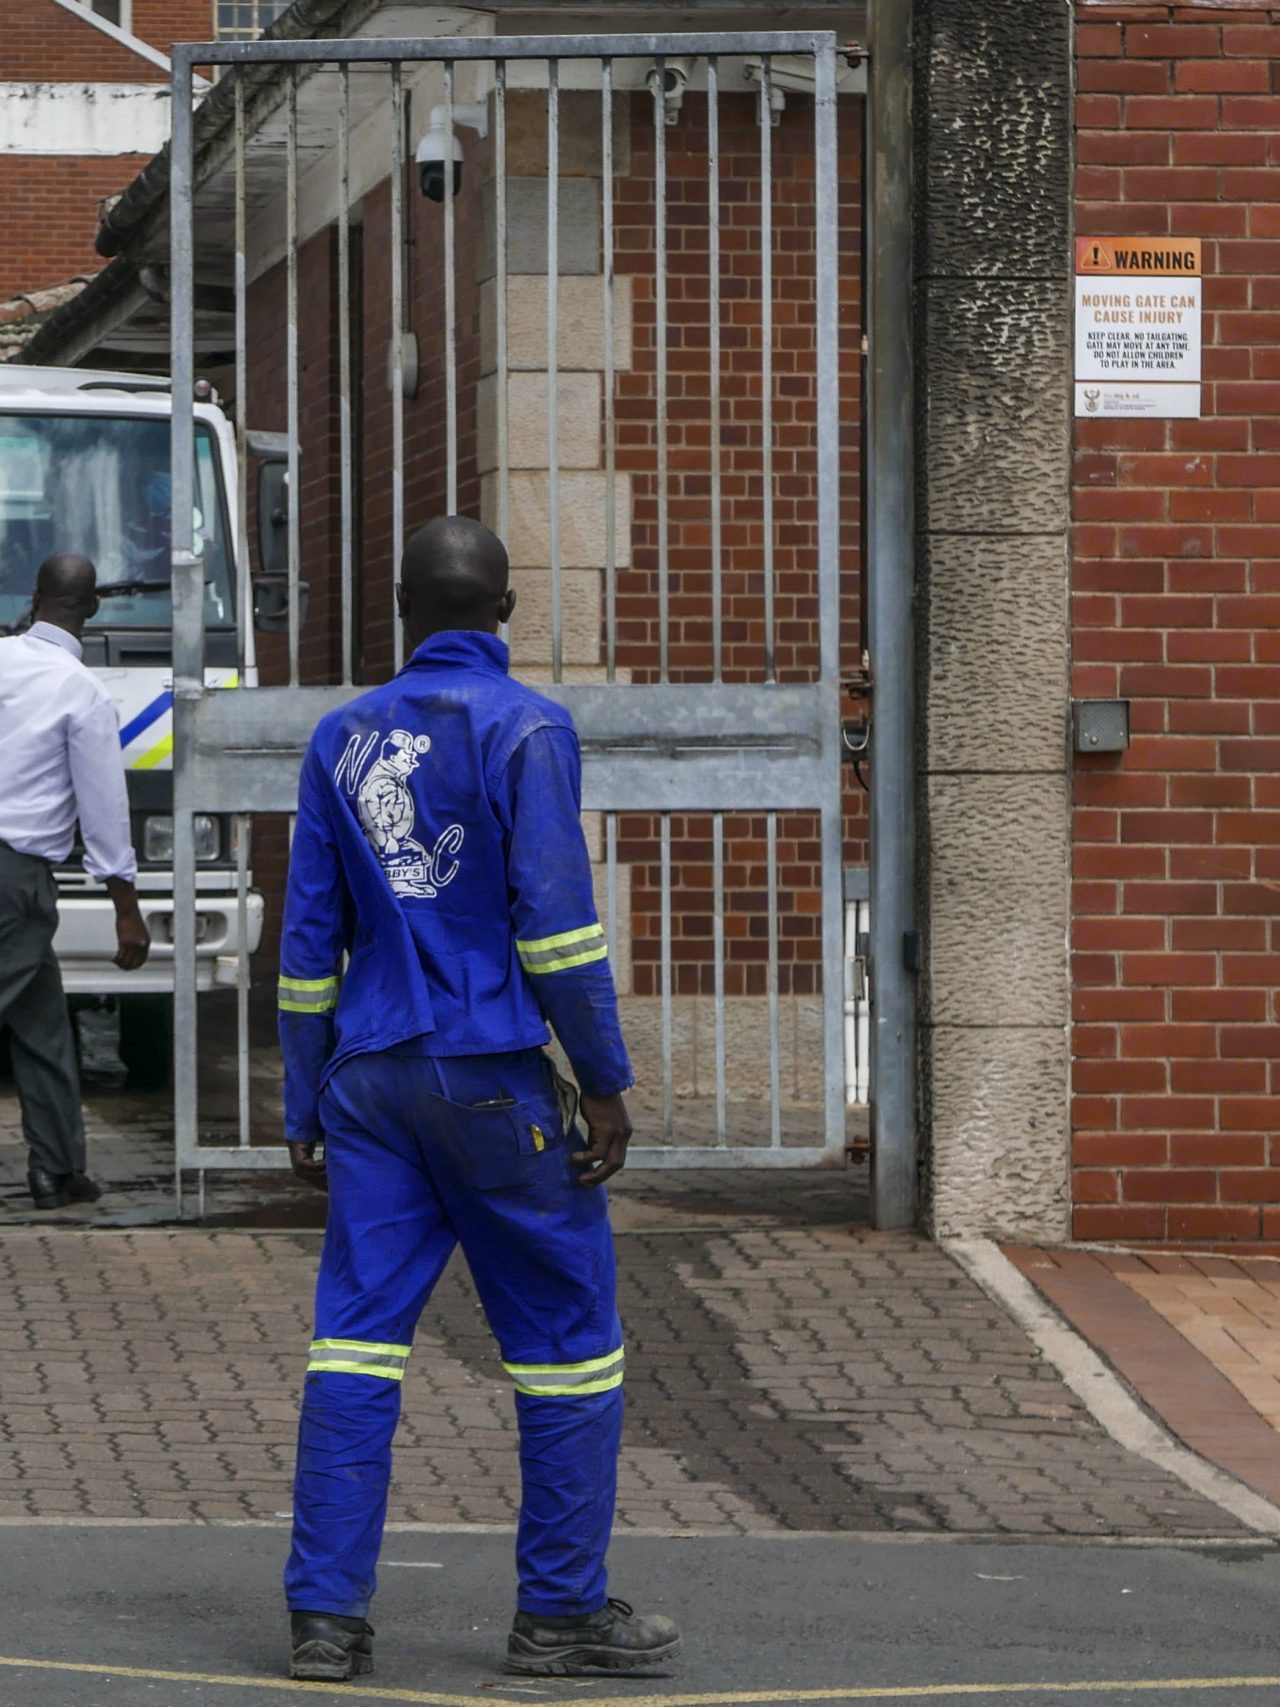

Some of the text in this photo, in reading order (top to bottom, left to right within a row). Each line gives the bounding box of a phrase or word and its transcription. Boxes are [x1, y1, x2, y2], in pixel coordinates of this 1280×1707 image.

[1114, 250, 1195, 270] WARNING
[1081, 294, 1195, 308] MOVING GATE CAN
[1094, 310, 1183, 324] CAUSE INJURY
[1087, 331, 1106, 340] KEEP
[1134, 332, 1145, 341] NO
[1086, 341, 1103, 349] GATE
[1106, 341, 1121, 350] MAY
[1123, 341, 1143, 350] MOVE
[1145, 341, 1154, 350] AT
[1156, 341, 1170, 350] ANY
[1093, 351, 1184, 360] DO NOT ALLOW CHILDREN
[1100, 360, 1109, 368] TO
[1111, 360, 1129, 369] PLAY
[1131, 360, 1139, 369] IN
[1141, 360, 1154, 369] THE
[334, 730, 380, 796] N
[430, 824, 465, 887] C
[384, 867, 421, 879] BBY'S
